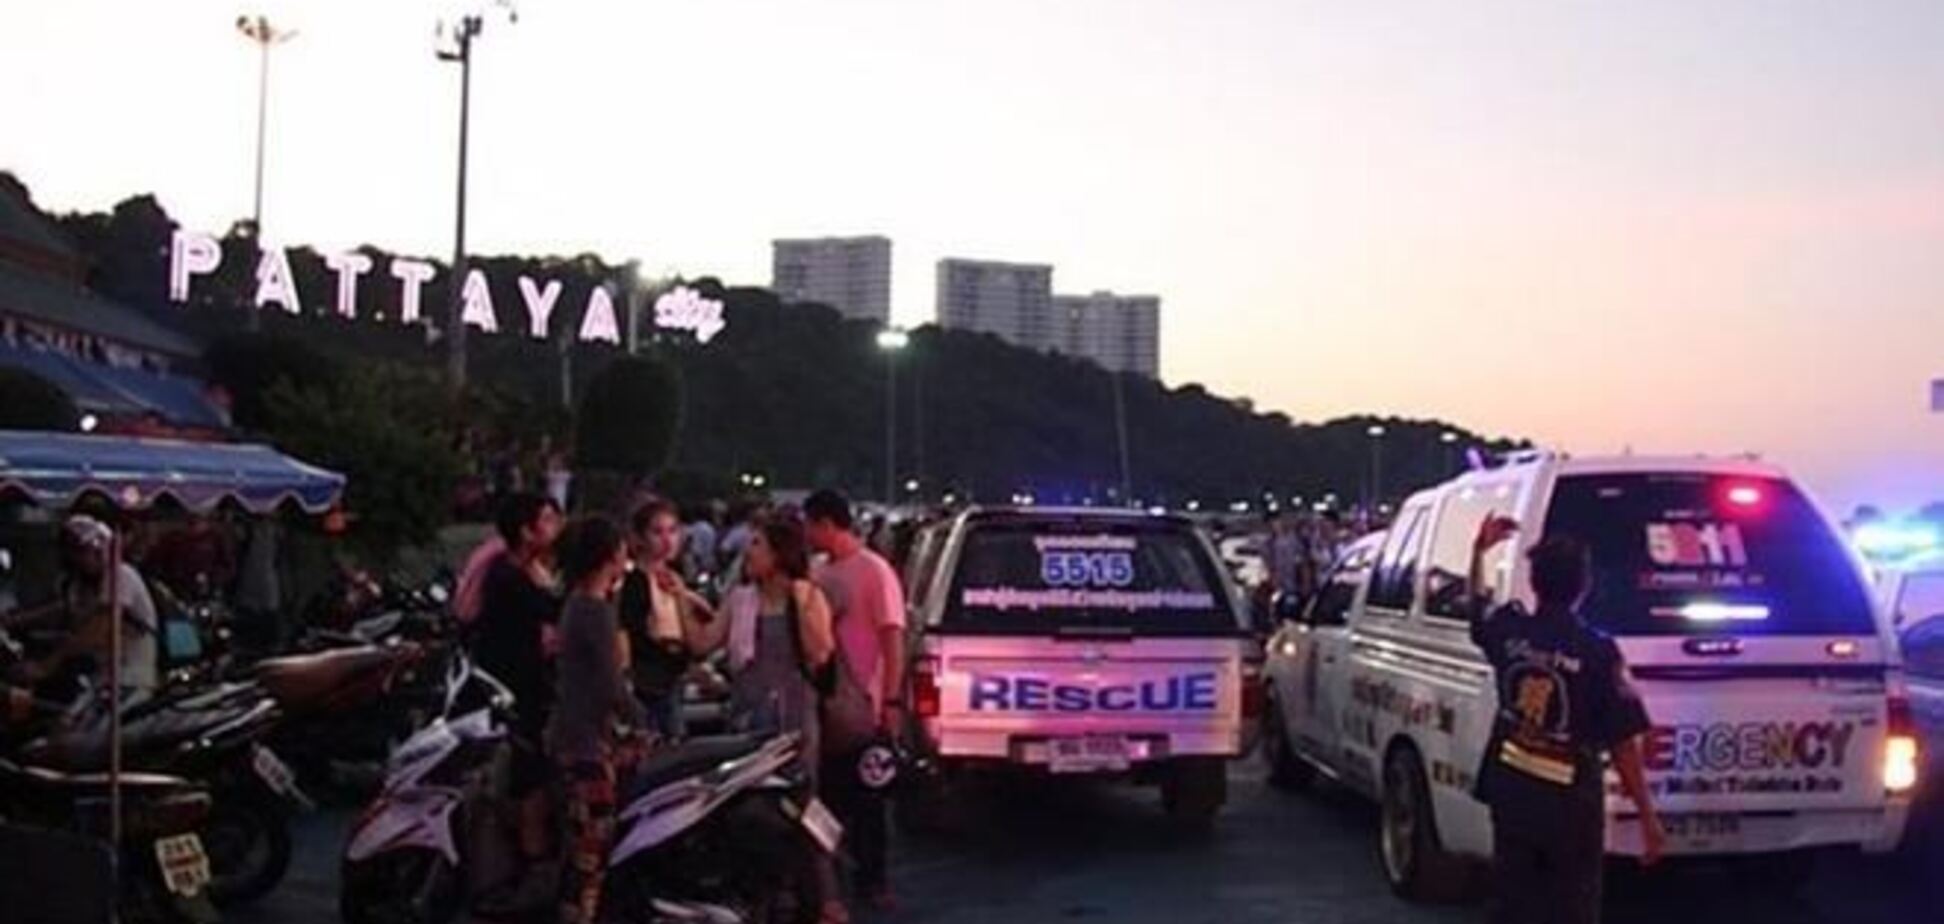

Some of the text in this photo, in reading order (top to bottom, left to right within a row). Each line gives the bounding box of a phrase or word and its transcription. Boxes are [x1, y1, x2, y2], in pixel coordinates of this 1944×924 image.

[169, 229, 621, 346] PATTAYA
[1041, 551, 1134, 586] 5515
[969, 672, 1217, 711] RESCUE
[1644, 721, 1855, 772] ERGENCY
